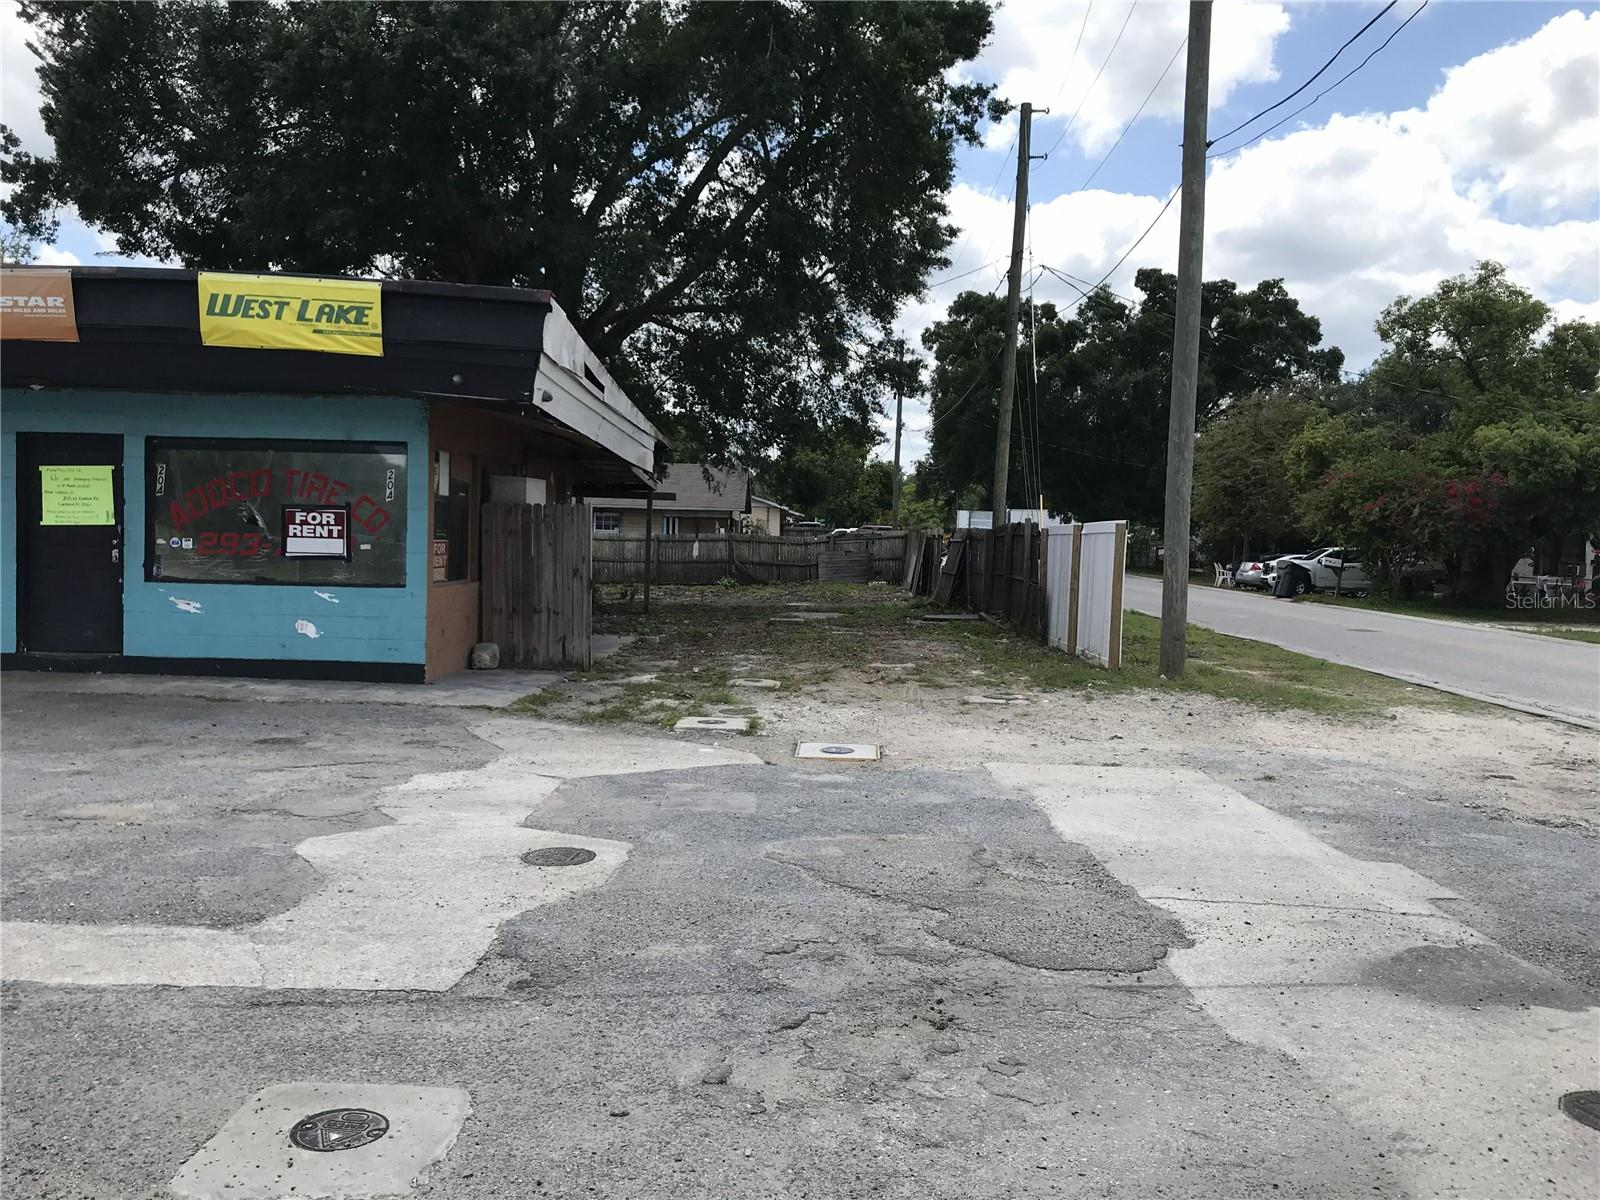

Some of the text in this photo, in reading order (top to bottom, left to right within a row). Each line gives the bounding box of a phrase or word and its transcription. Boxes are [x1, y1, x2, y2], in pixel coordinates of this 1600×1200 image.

[0, 296, 65, 307] STAR
[206, 293, 373, 326] WEST LAKE
[157, 465, 165, 495] 204
[285, 467, 350, 505] TIRE
[386, 469, 395, 500] 204
[288, 524, 343, 538] RENT
[295, 511, 336, 525] FOR
